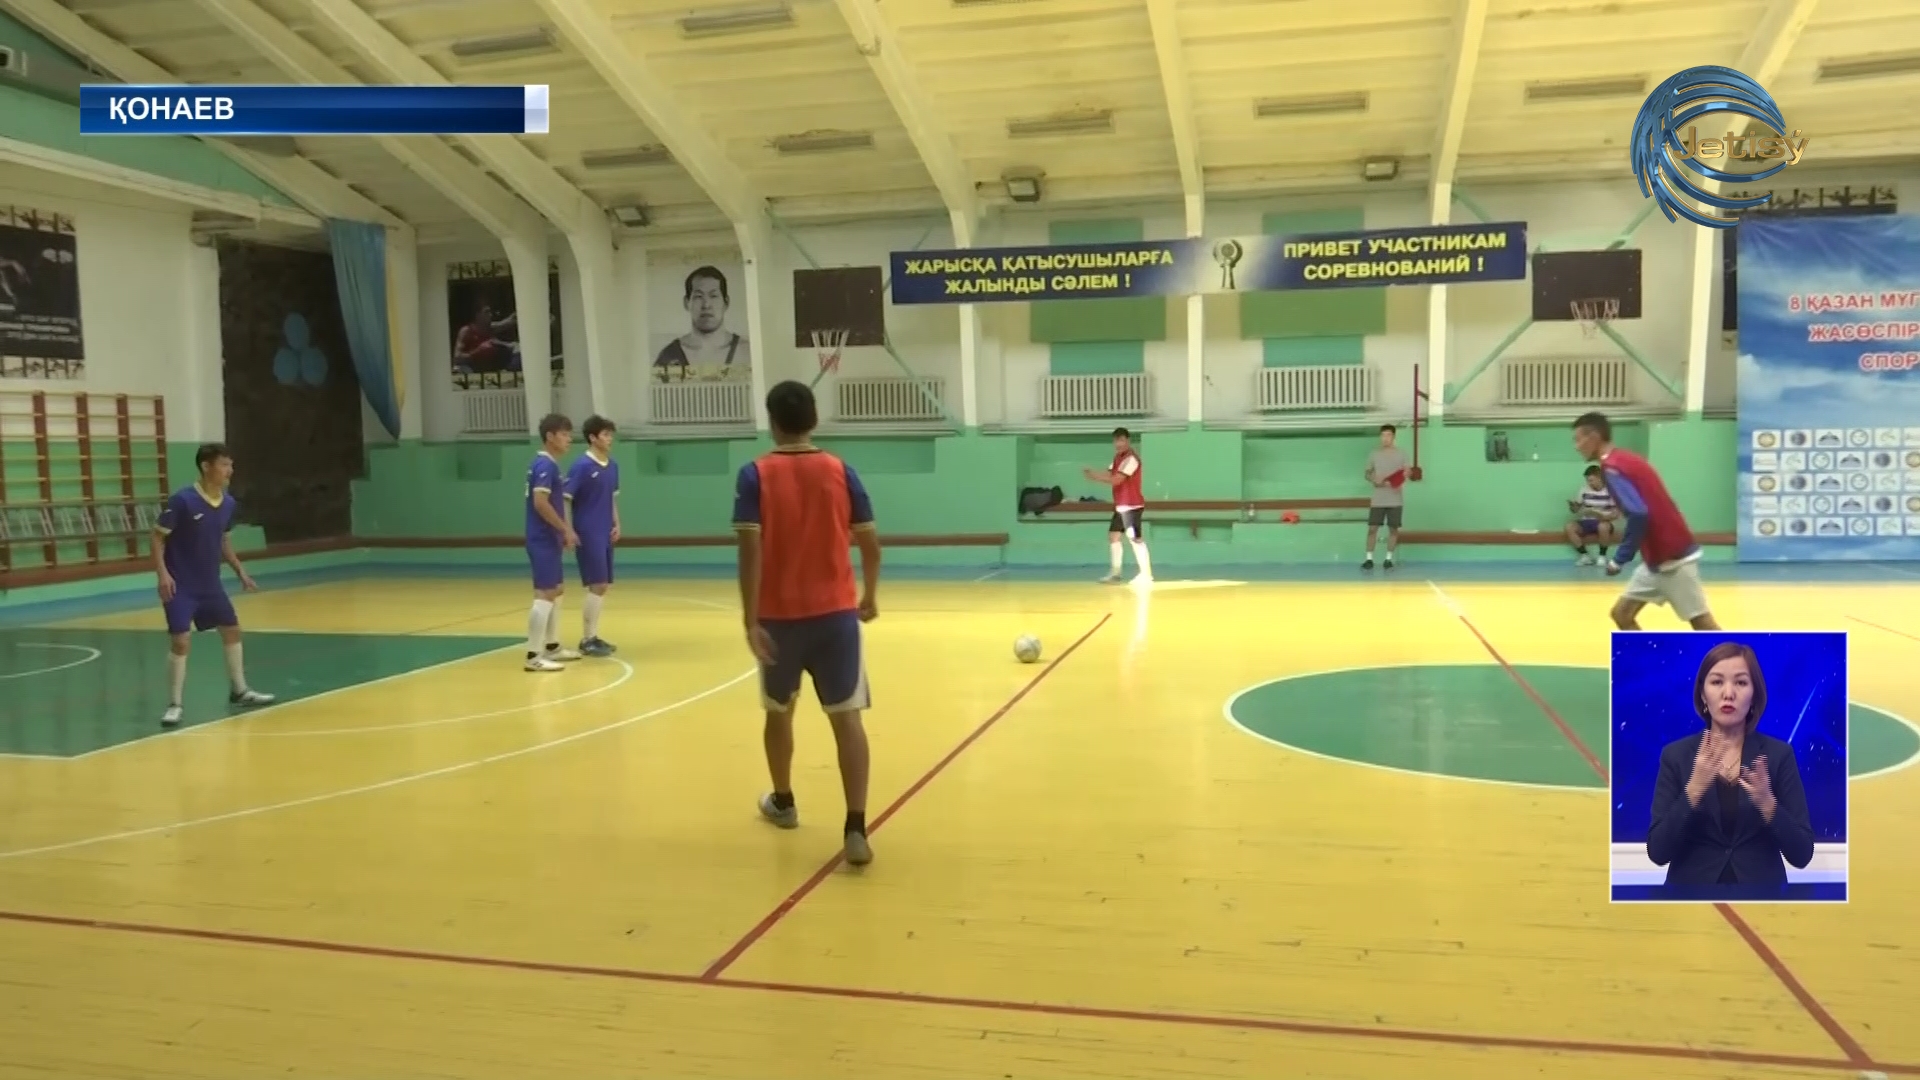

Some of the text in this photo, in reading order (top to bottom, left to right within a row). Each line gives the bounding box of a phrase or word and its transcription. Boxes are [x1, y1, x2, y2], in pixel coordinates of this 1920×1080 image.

[1284, 232, 1506, 258] ПРИВЕТ УЧАСТНИКАМ
[905, 250, 1174, 276] ЖАРЫСҚА ҚАТЫСУШЫЛАРҒА
[1303, 256, 1470, 280] СОРЕВНОВАНИЙ
[945, 275, 1046, 295] ЖАЛЫНДЫ
[1051, 273, 1118, 290] СӘЛЕМ
[1789, 296, 1800, 311] 8
[1806, 295, 1873, 312] ҚАЗАН
